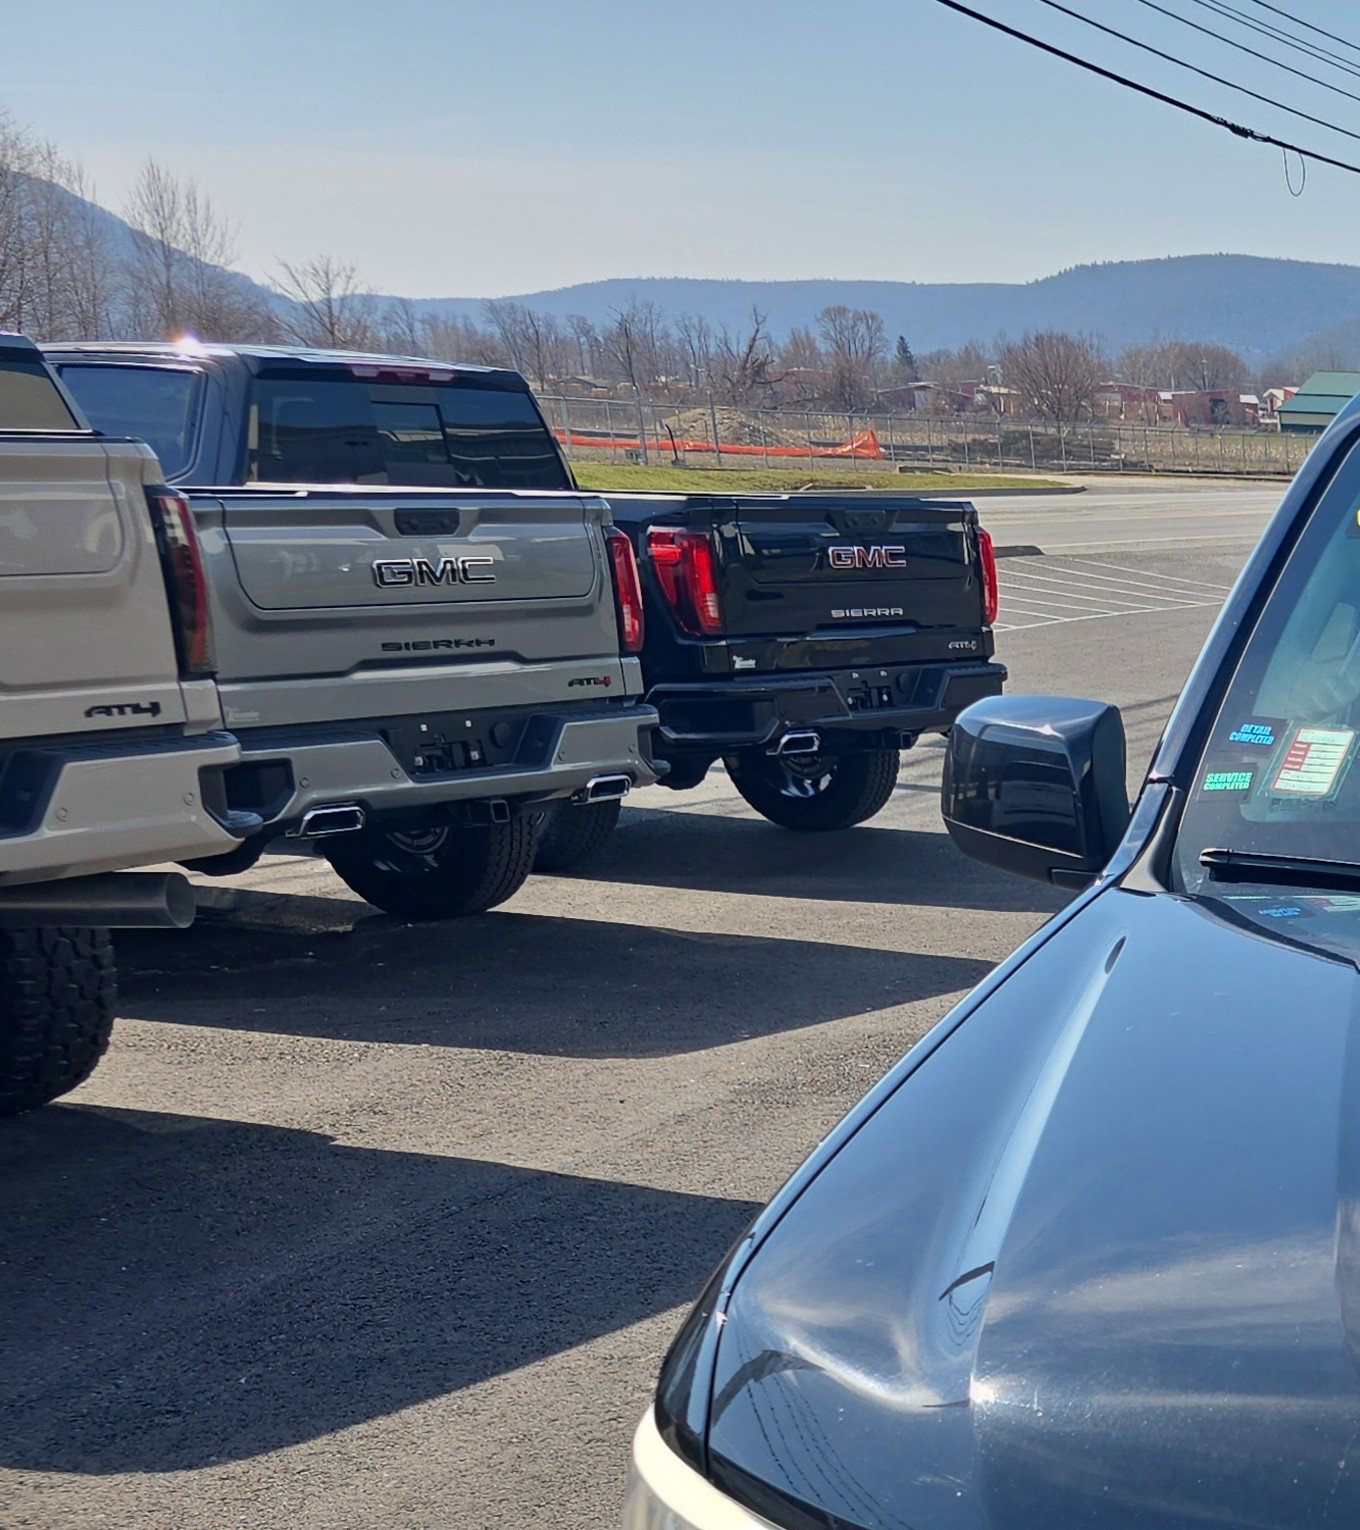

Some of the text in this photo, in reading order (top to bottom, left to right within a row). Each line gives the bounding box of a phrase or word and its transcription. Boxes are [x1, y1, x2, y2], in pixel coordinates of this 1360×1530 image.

[828, 545, 907, 569] GMC
[372, 556, 496, 588] GMC
[831, 607, 904, 618] SIERRA
[381, 638, 496, 652] SIERRA
[948, 640, 977, 651] AT4
[568, 675, 611, 688] AT4
[84, 701, 161, 718] AT4
[1239, 723, 1273, 736] DETAIL
[1228, 731, 1275, 745] COMPLETED
[1205, 771, 1253, 783] SERVICE
[1203, 782, 1250, 791] COMPLETED
